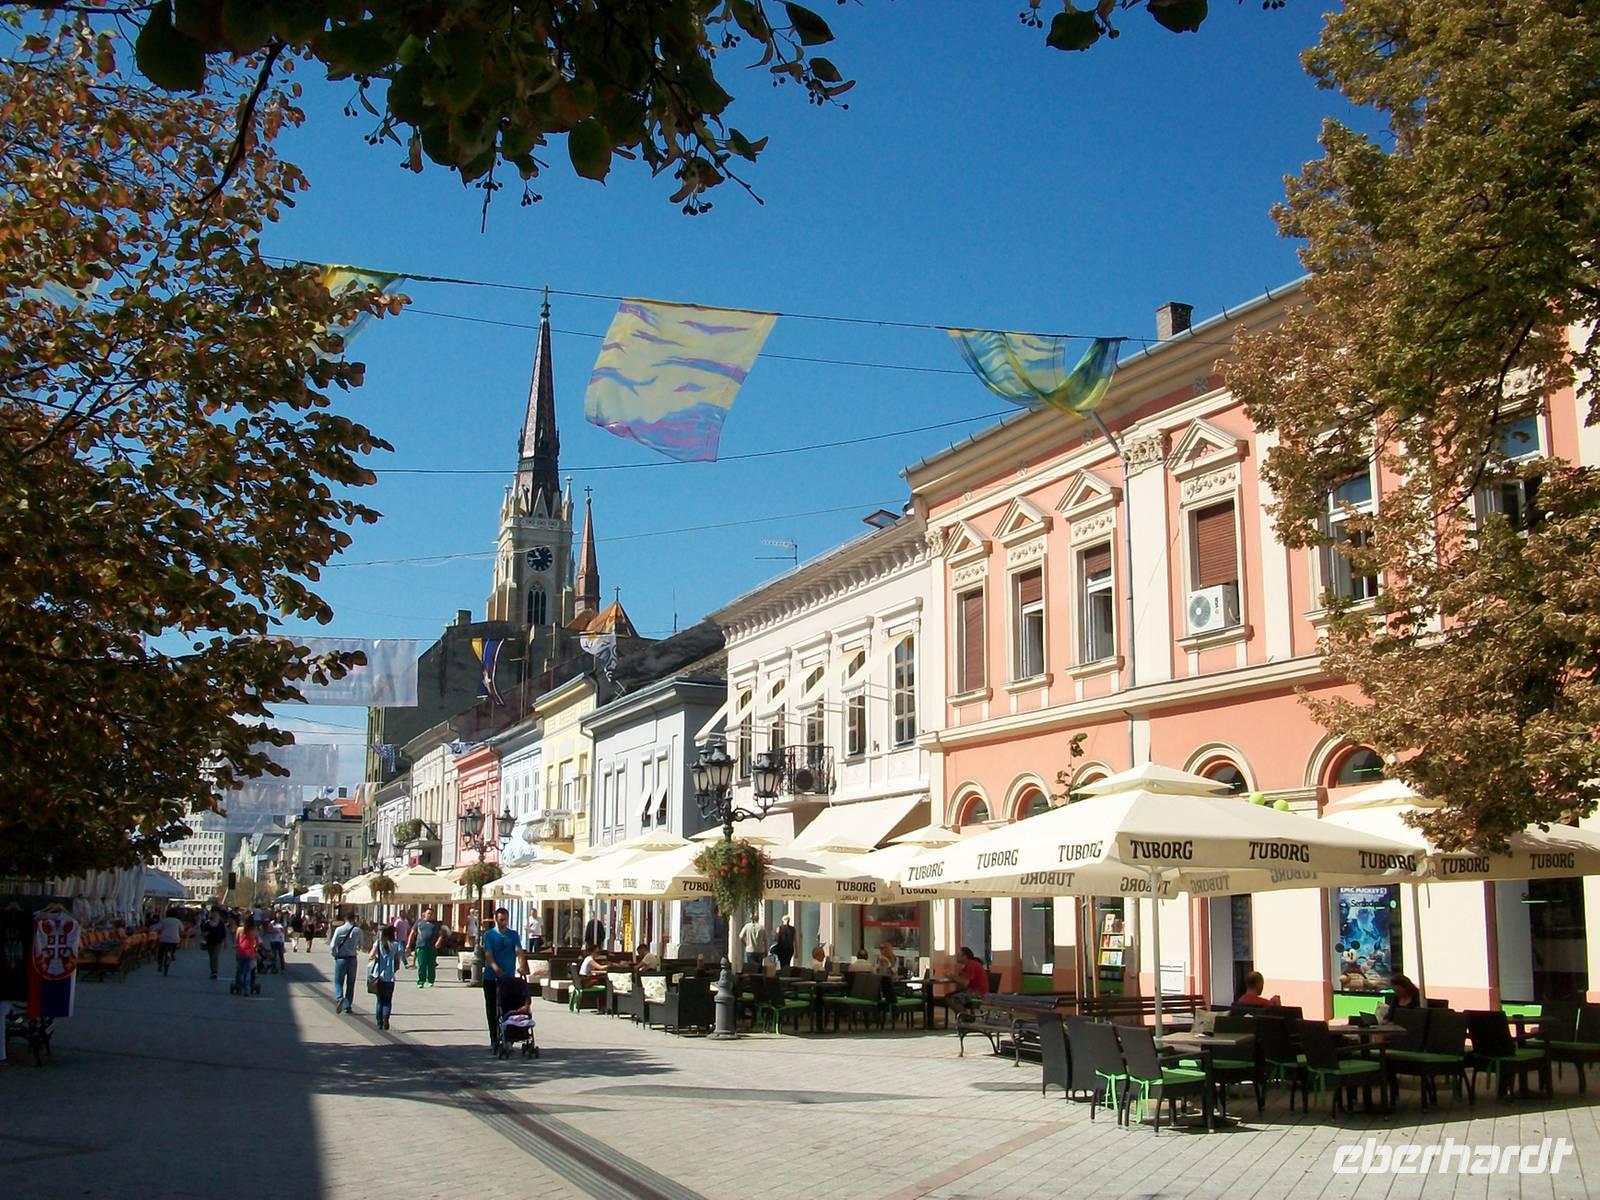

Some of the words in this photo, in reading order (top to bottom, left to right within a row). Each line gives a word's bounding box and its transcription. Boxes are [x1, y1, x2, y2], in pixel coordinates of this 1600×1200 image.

[1130, 840, 1193, 859] TUBORG
[1249, 841, 1309, 862] TUBORG
[977, 849, 1018, 870] TUBORG
[1359, 850, 1416, 871] TUBORG
[1441, 856, 1489, 874] TUBORG
[1530, 852, 1574, 870] TUBORG
[908, 861, 944, 881] TUBORG
[836, 880, 876, 892] TUBORG
